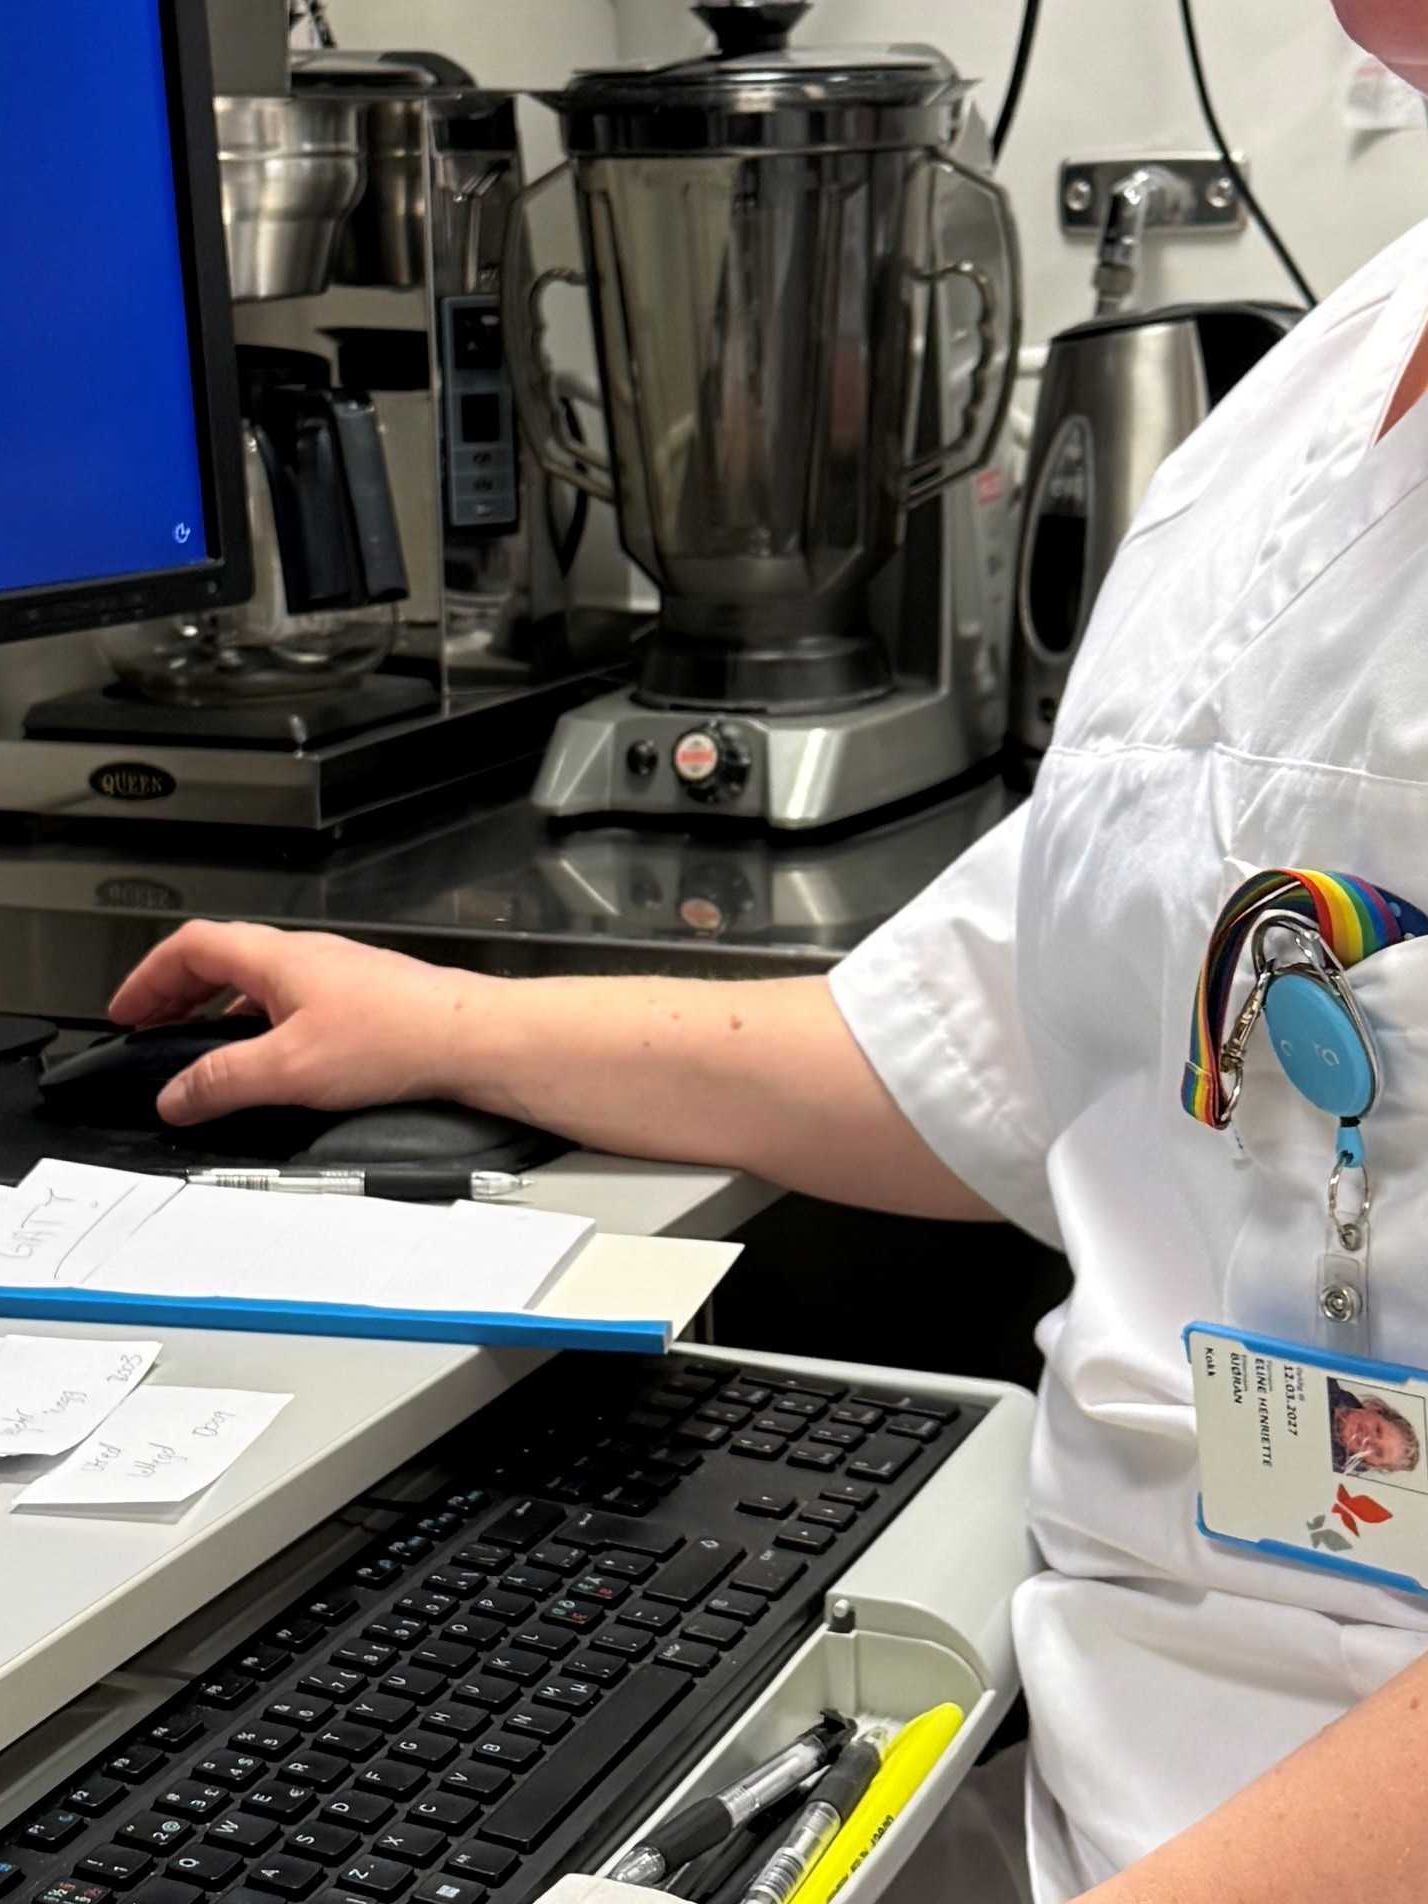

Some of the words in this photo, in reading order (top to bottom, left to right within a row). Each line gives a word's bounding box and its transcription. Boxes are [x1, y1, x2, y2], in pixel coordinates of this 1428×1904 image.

[1204, 1346, 1217, 1378] Kokk
[1254, 1357, 1268, 1395] ELINE
[1258, 1396, 1273, 1469] HENRIETTE
